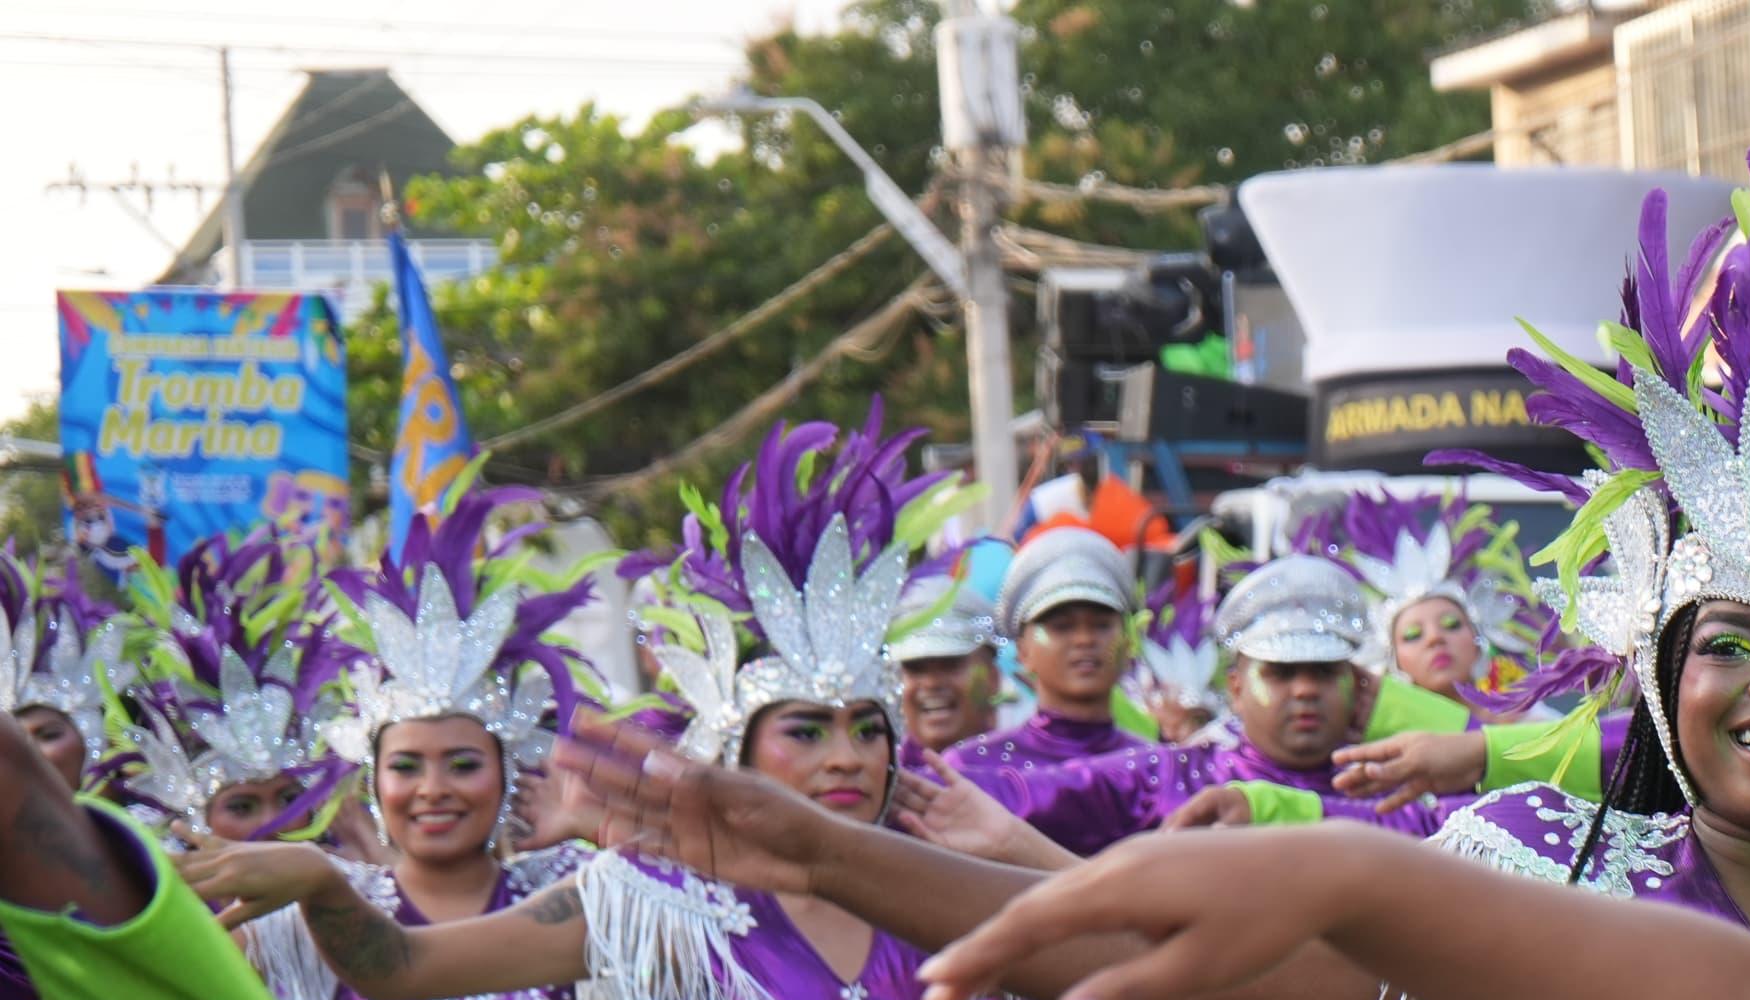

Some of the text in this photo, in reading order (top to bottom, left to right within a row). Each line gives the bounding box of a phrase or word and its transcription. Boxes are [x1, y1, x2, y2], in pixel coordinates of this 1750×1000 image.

[117, 360, 303, 408] Tromba
[99, 407, 281, 457] Marina
[1326, 389, 1528, 441] ARMADA NA
